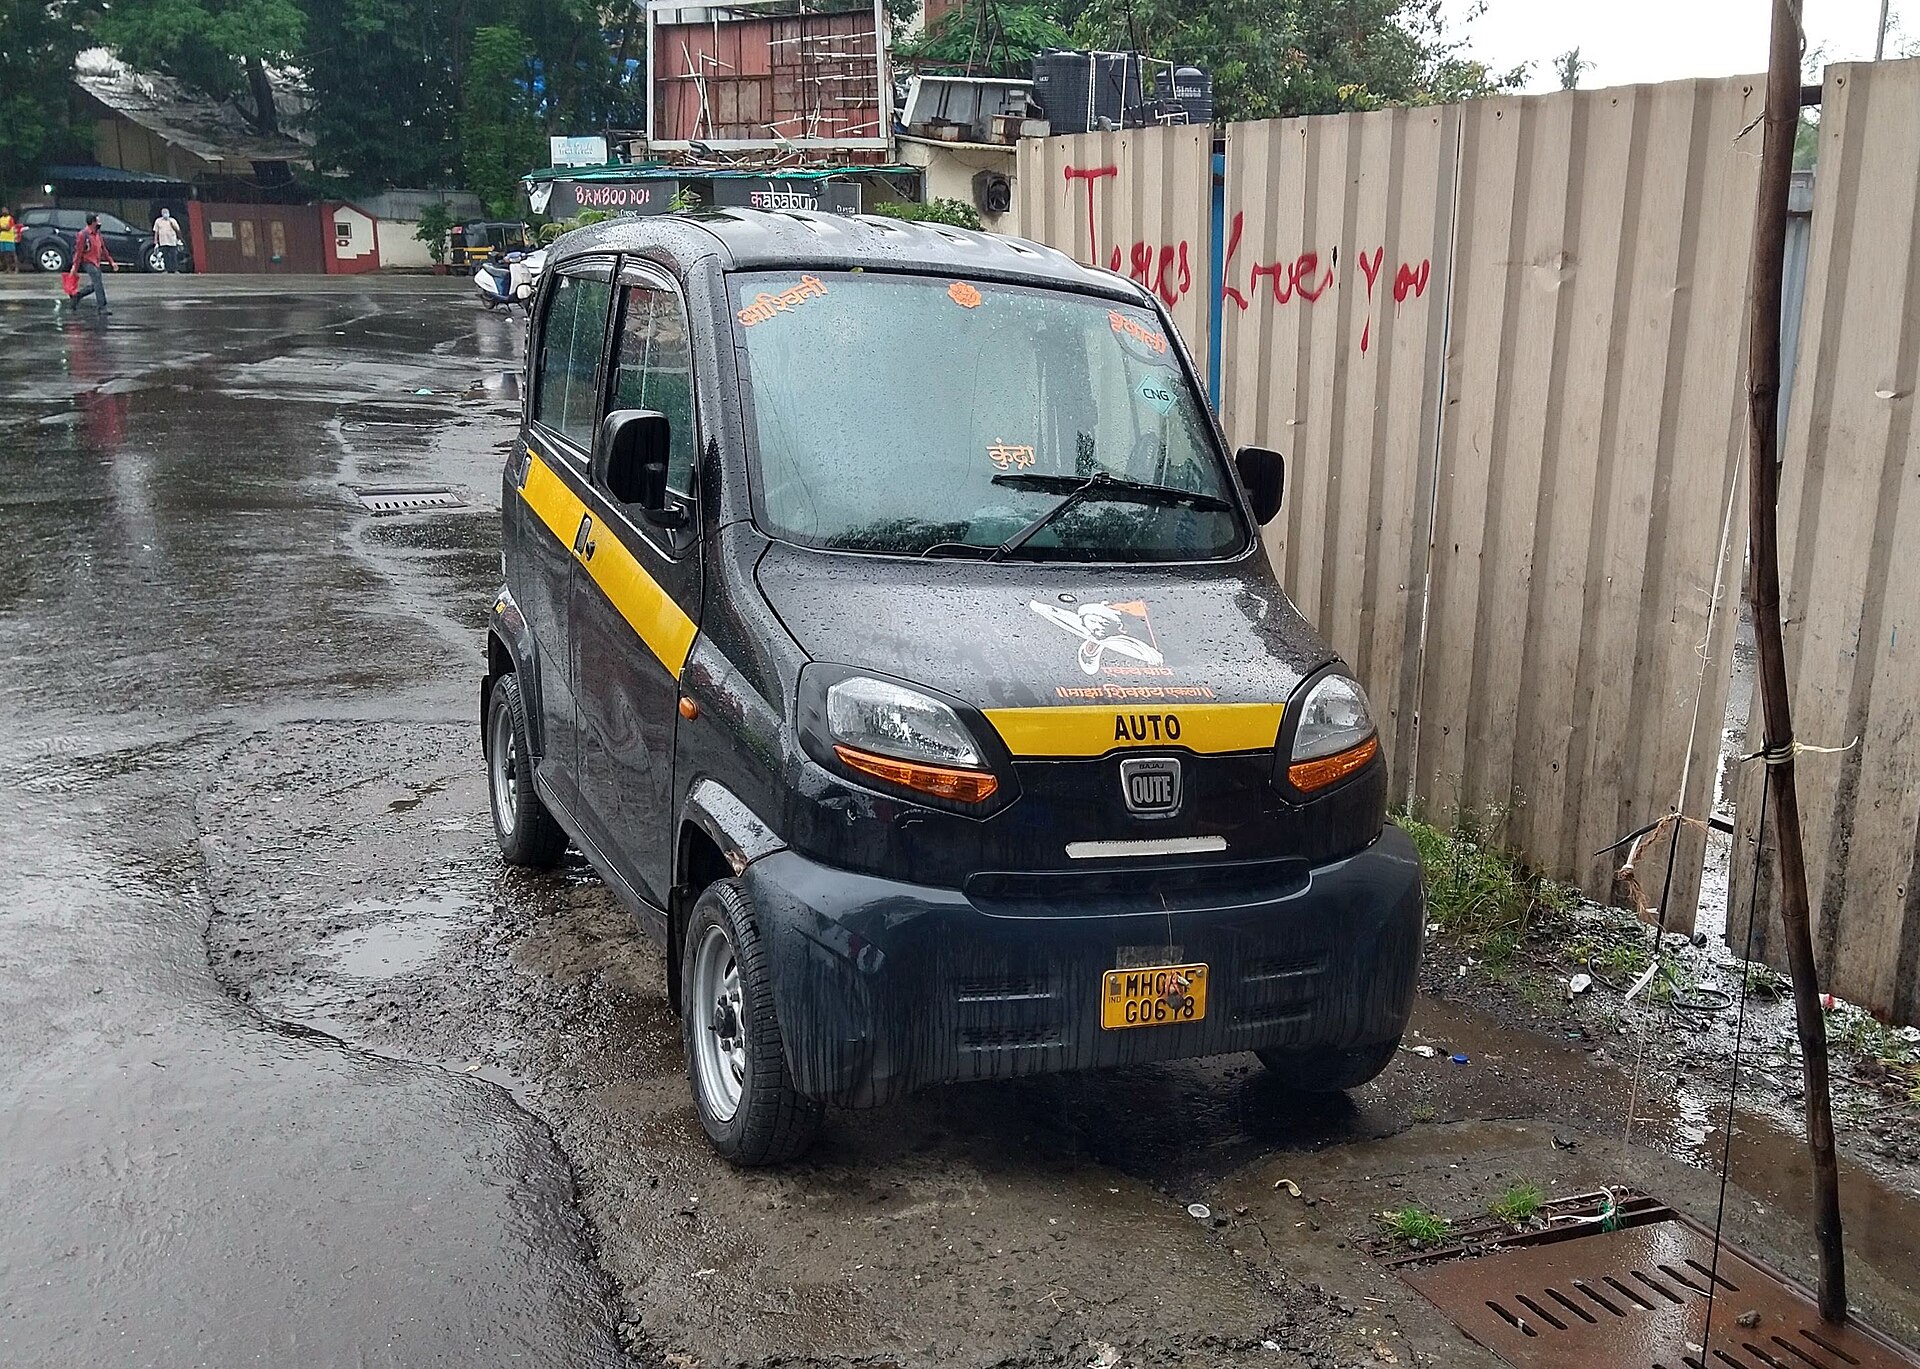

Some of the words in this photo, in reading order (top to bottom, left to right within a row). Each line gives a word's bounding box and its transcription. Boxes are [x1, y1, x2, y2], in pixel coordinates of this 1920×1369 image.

[575, 185, 626, 206] BAMBOO
[1143, 388, 1169, 401] CNG
[1114, 714, 1181, 741] AUTO
[1132, 775, 1172, 803] QUTE
